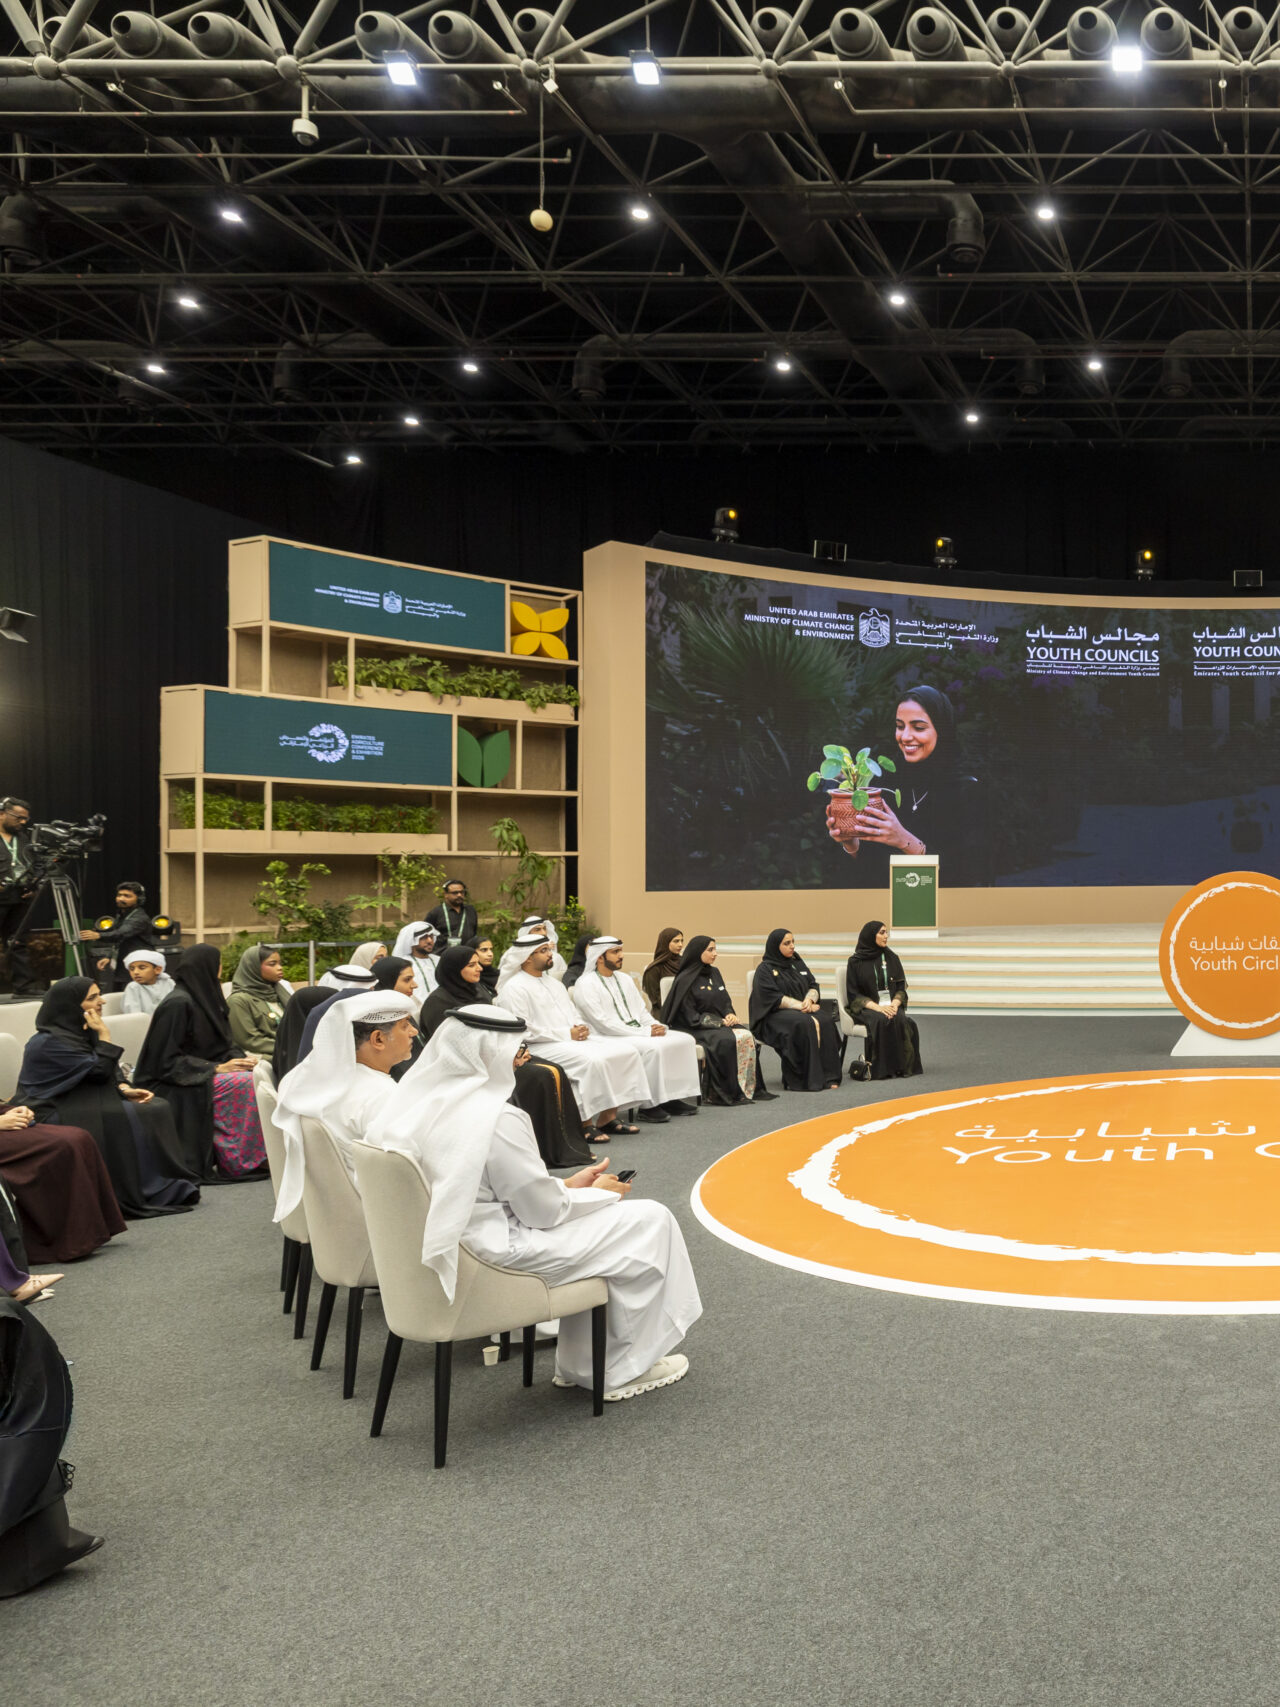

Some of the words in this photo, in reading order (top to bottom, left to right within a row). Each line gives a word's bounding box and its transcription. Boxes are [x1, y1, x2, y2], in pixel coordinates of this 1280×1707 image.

[769, 606, 796, 616] UNITED
[798, 608, 818, 618] ARAB
[819, 610, 854, 622] EMIRATES
[744, 613, 780, 625] MINISTRY
[781, 616, 791, 625] OF
[792, 618, 822, 629] CLIMATE
[824, 621, 854, 632] CHANGE
[895, 618, 921, 628] المتحدة
[921, 620, 948, 630] العربية
[794, 629, 801, 637] &
[802, 630, 854, 641] ENVIRONMENT
[982, 634, 1000, 644] وزارة
[1025, 624, 1087, 644] الشباب
[1092, 627, 1160, 646] مجالس
[1193, 625, 1246, 643] الشباب
[1026, 646, 1081, 661] YOUTH
[1084, 648, 1160, 662] COUNCILS
[1193, 646, 1241, 658] YOUTH
[1189, 936, 1245, 954] شبابية
[1190, 955, 1237, 971] Youth
[955, 1120, 1256, 1142] شبابية
[943, 1142, 1214, 1164] Youth
